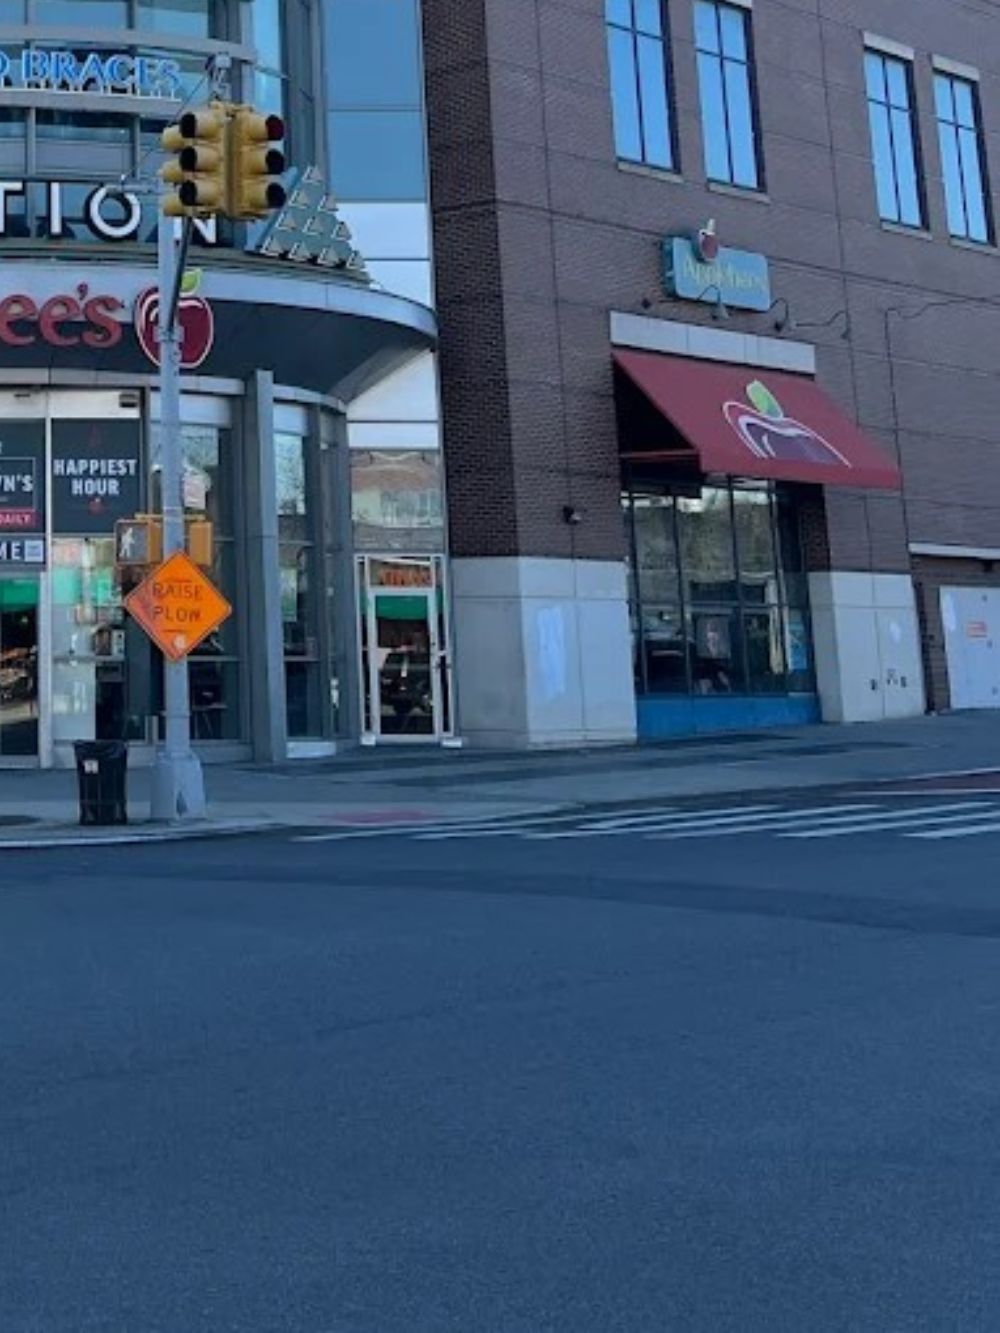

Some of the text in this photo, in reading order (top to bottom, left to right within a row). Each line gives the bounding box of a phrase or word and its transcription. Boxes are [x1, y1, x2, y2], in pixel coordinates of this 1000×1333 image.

[22, 49, 182, 90] BRACES
[53, 459, 137, 476] HAPPIEST
[71, 478, 120, 495] HOUR
[152, 582, 204, 601] RAISE
[152, 606, 201, 623] PLOW
